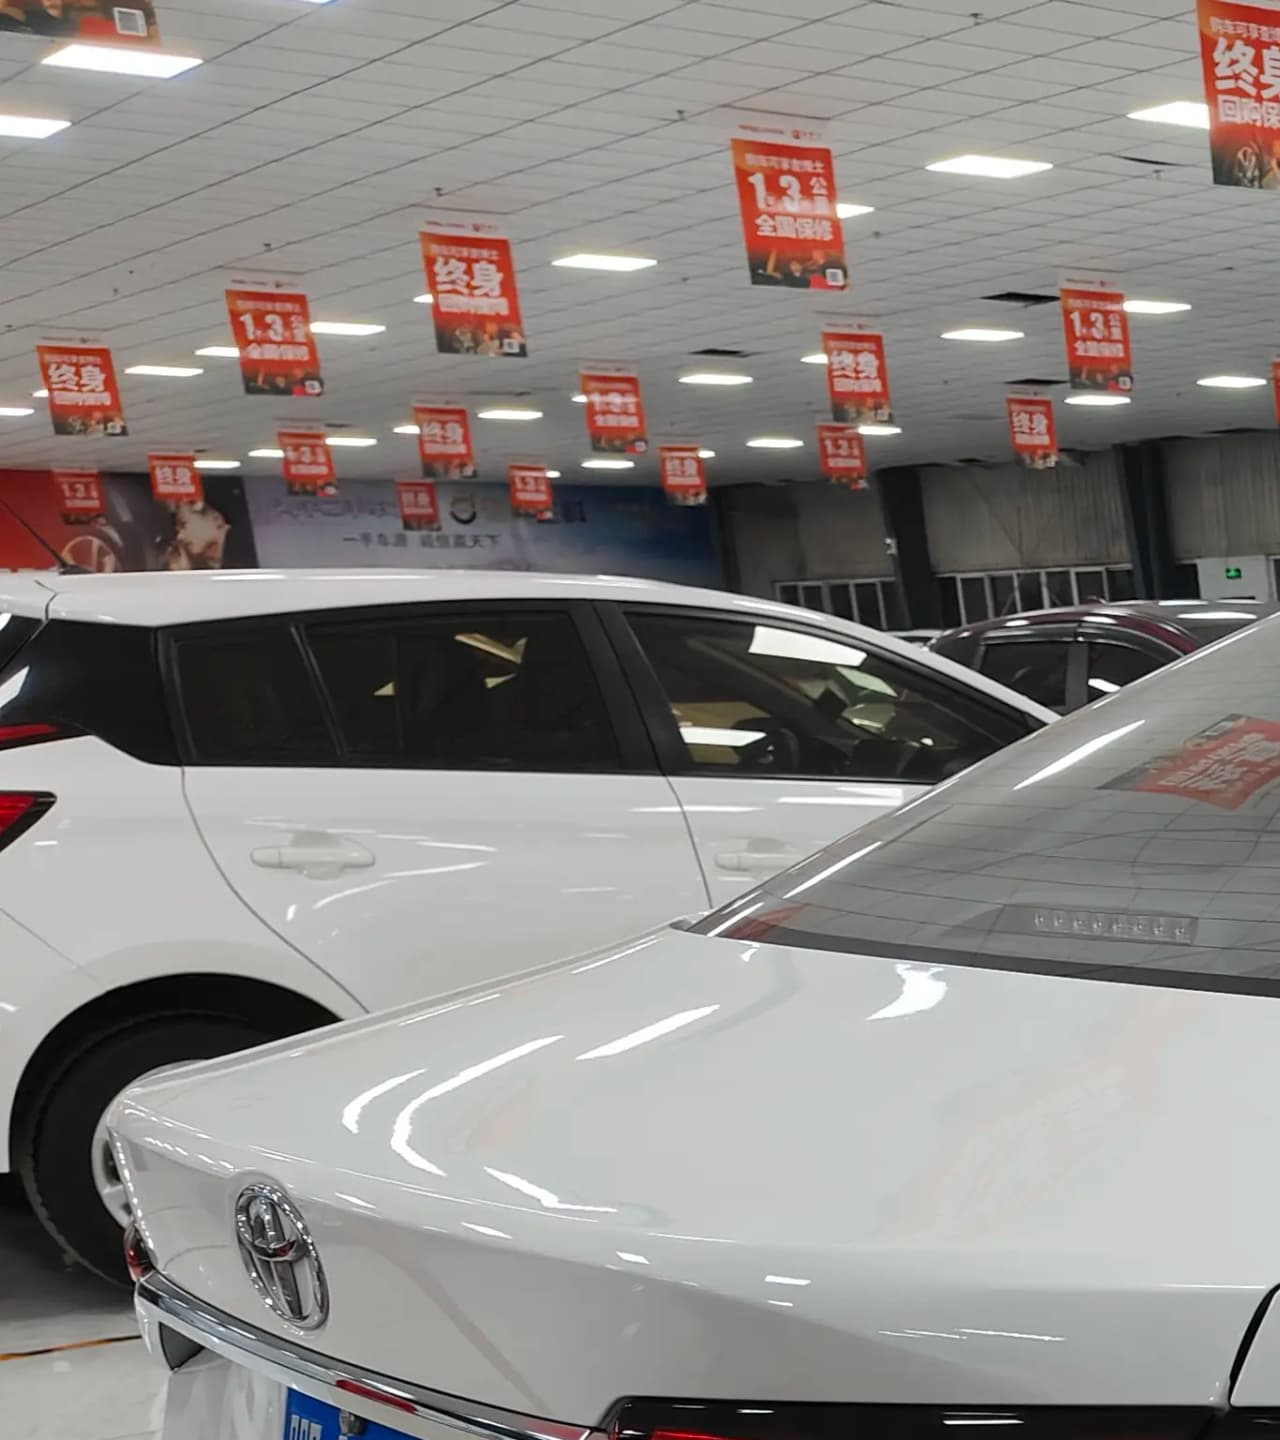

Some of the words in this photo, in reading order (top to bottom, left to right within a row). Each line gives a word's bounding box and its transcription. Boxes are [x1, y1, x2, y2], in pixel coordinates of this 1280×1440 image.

[433, 256, 503, 297] 终身
[48, 362, 106, 391] 终身
[830, 349, 879, 378] 终身
